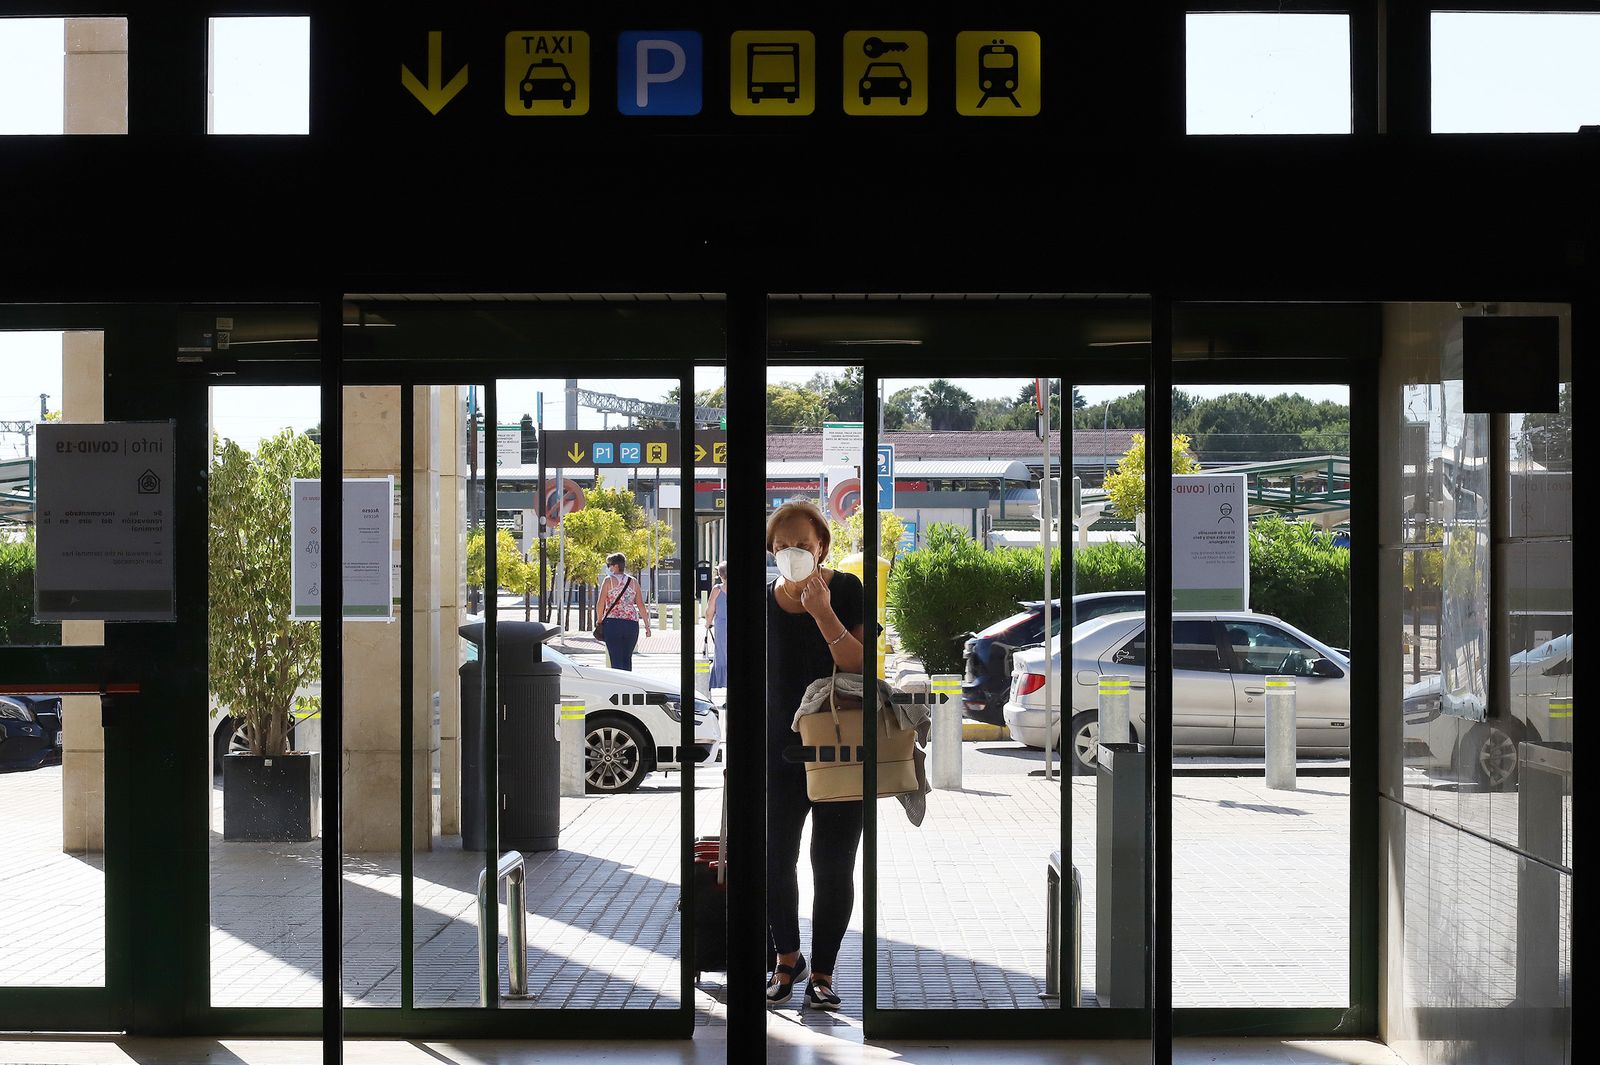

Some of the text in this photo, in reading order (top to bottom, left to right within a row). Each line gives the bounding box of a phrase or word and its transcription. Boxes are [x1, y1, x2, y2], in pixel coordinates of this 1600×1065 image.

[521, 36, 573, 54] TAXI
[636, 39, 687, 108] P
[595, 447, 611, 459] P1
[621, 447, 639, 459] P2
